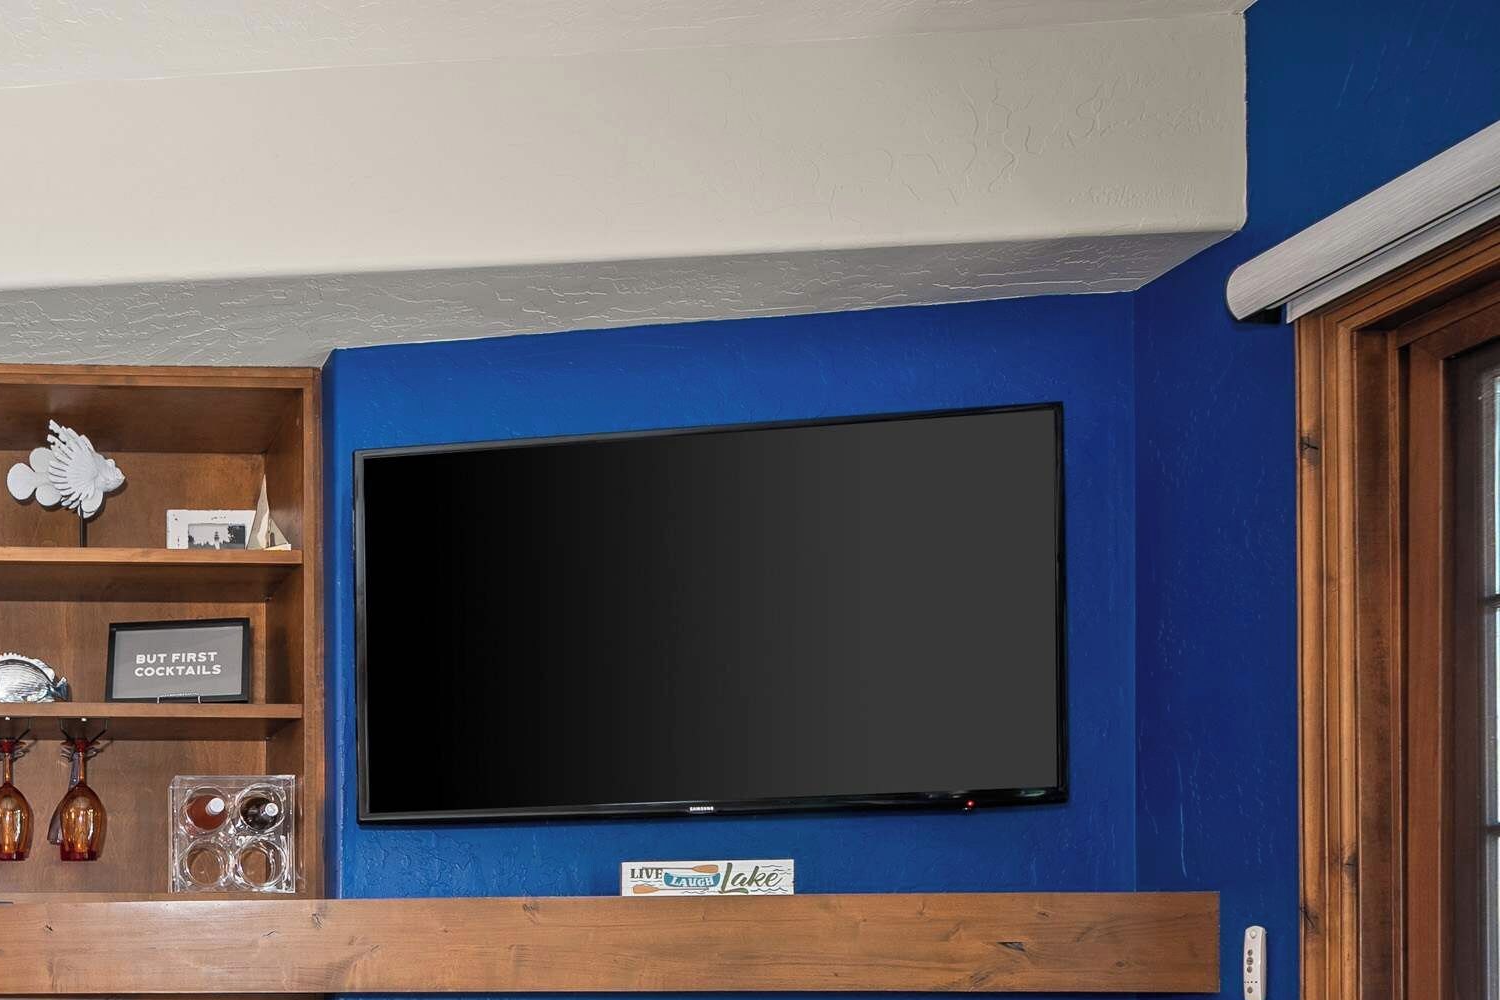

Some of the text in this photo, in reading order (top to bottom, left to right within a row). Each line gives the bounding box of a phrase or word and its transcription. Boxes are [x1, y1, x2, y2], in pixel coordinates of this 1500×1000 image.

[136, 652, 217, 664] BUT FIRST
[134, 665, 222, 676] COCKTAILS
[630, 862, 783, 894] LIVE LAUGH Lake
